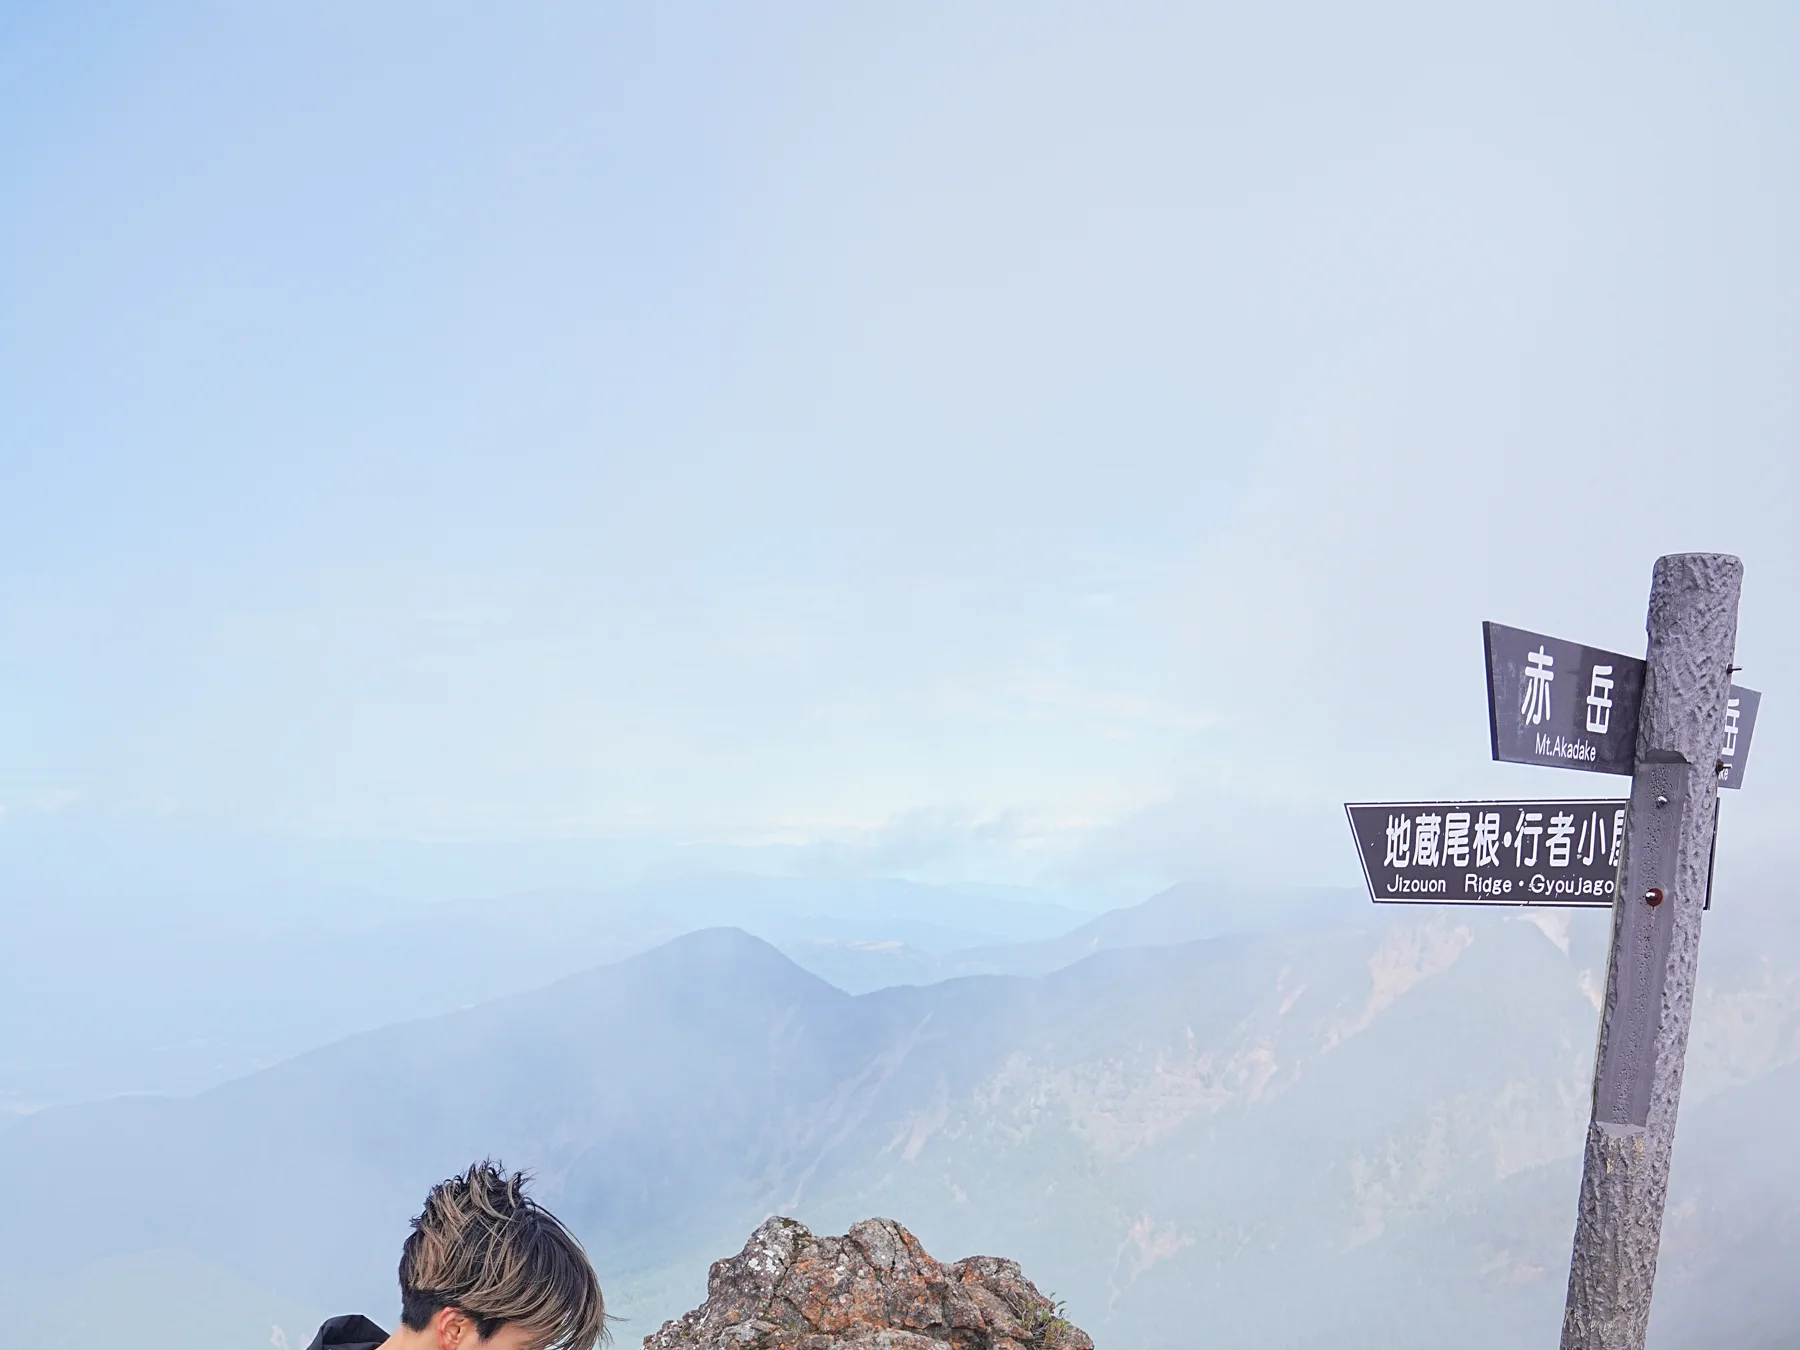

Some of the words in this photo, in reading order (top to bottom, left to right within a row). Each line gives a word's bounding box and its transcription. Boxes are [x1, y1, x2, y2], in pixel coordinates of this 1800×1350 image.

[1535, 732, 1596, 761] Mt.Akadake
[1387, 874, 1446, 892] Jizouon
[1465, 874, 1512, 895] Ridge
